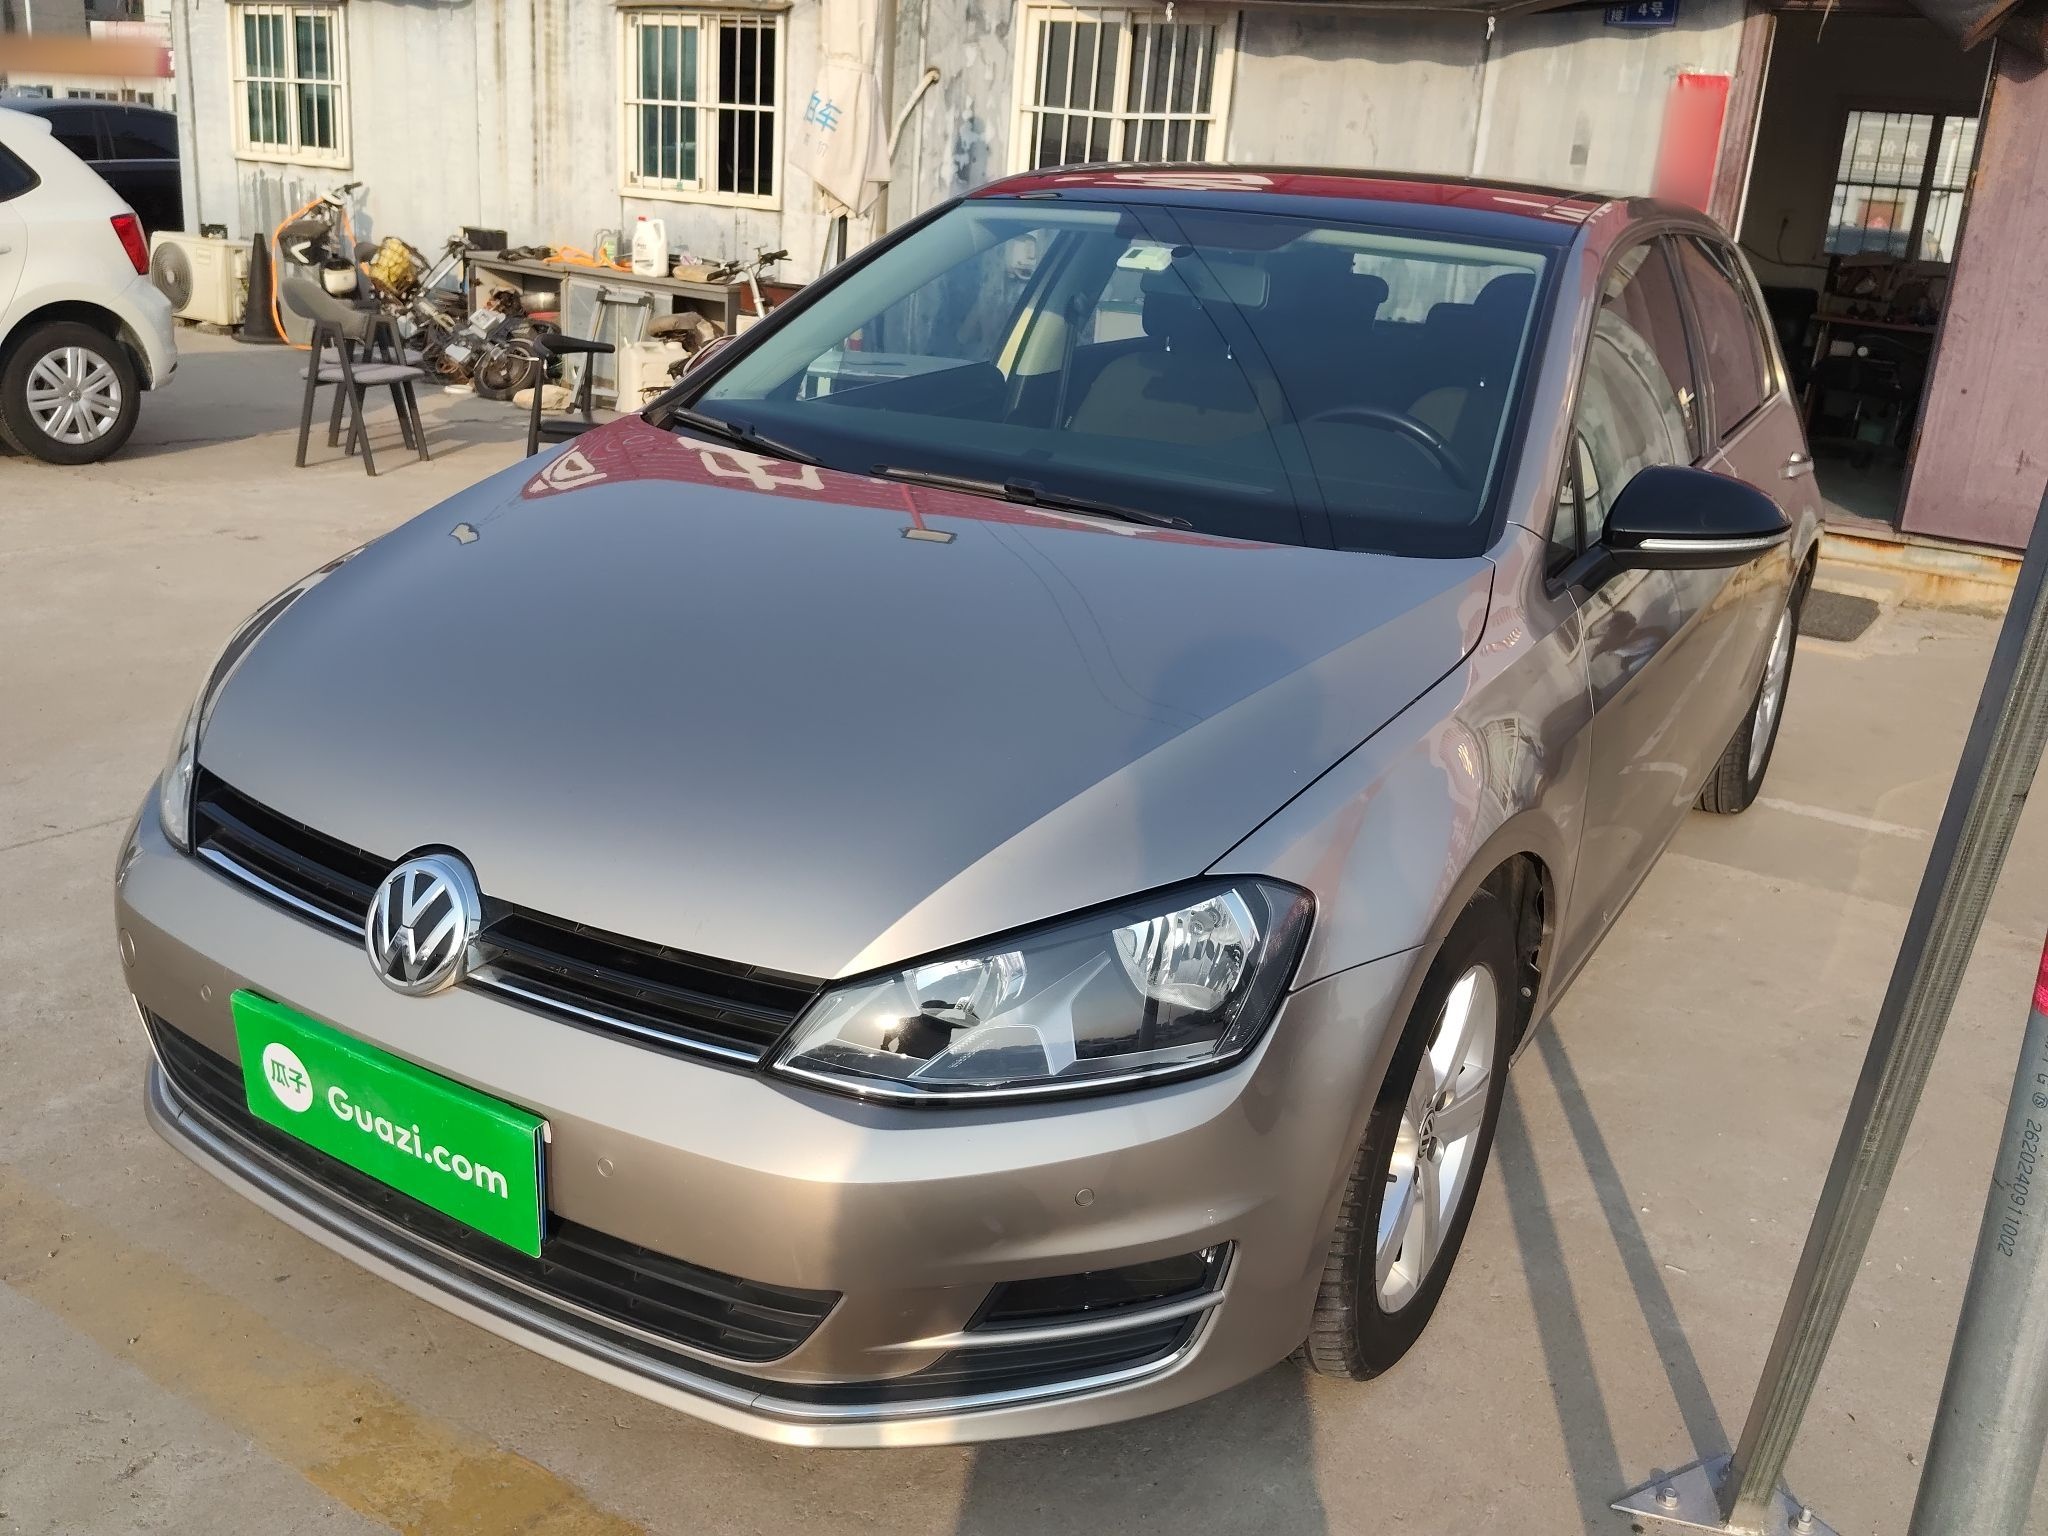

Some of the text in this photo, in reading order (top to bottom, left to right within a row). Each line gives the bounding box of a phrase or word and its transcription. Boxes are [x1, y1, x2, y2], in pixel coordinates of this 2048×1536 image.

[271, 1057, 307, 1095] 瓜子
[328, 1085, 508, 1199] Guazi.com
[1998, 1118, 2042, 1257] 2620240911002
